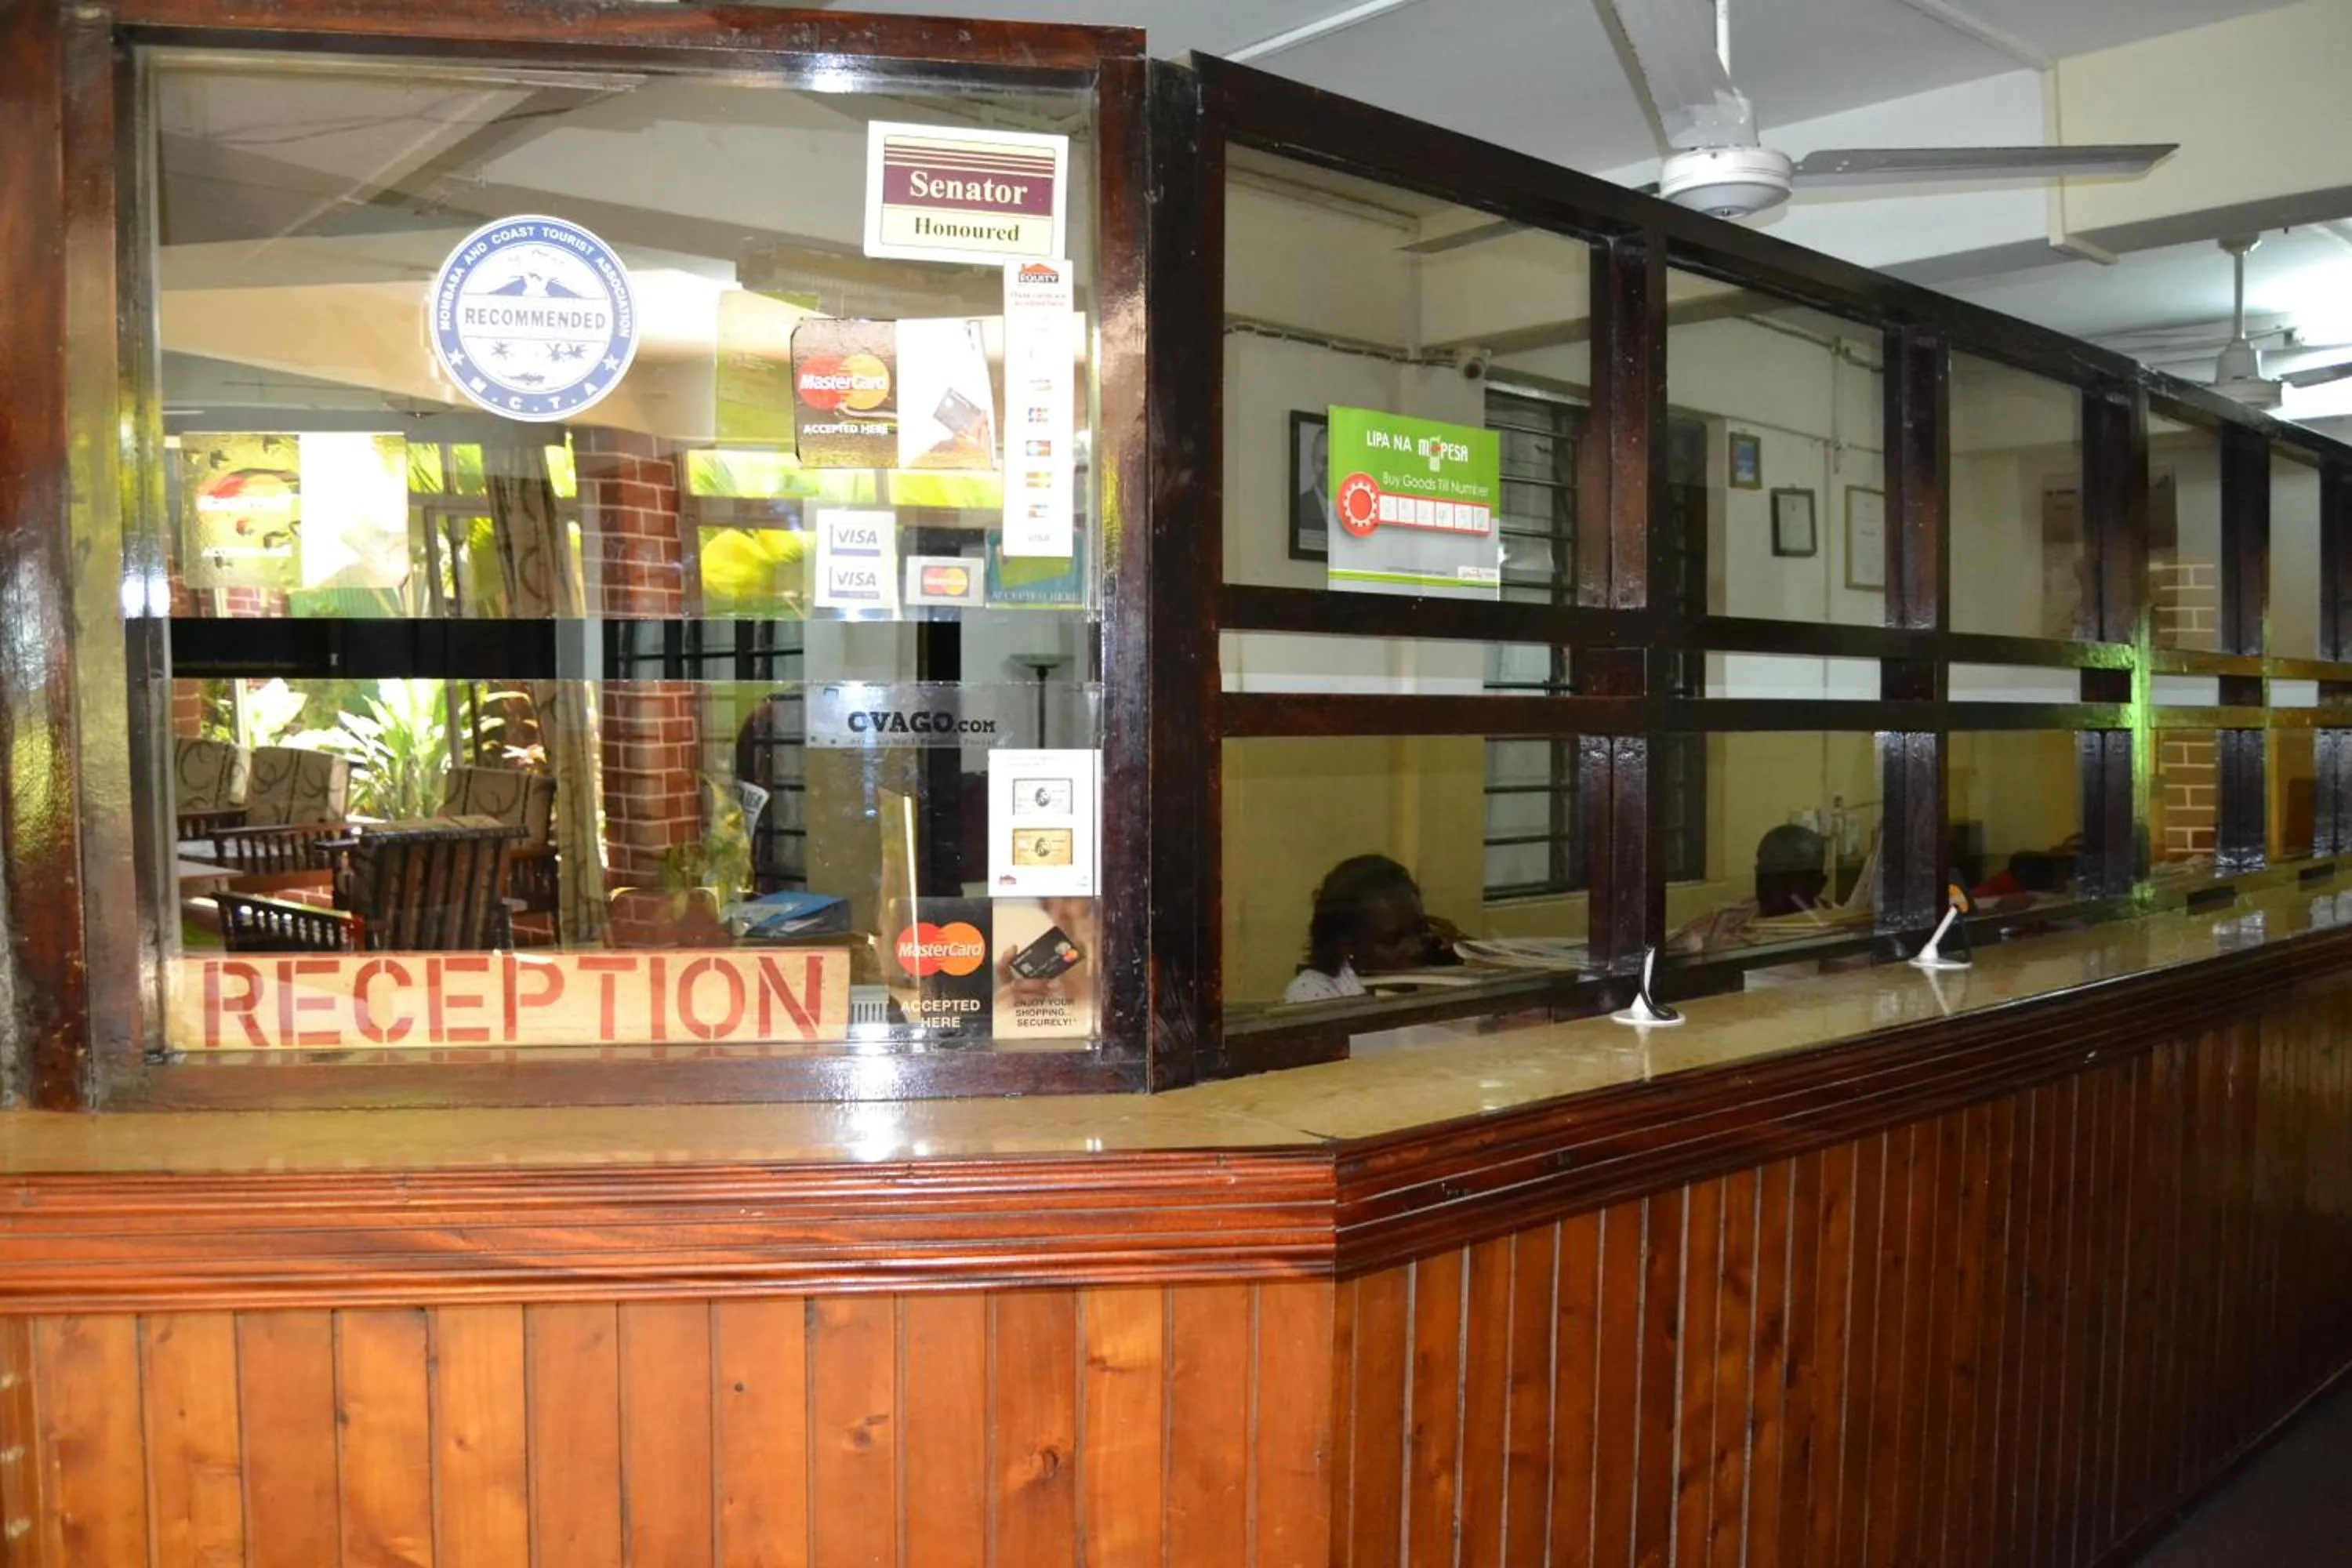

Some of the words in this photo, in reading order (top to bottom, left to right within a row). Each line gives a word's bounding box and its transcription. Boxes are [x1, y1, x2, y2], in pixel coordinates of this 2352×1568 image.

[909, 169, 1029, 205] Senator
[914, 216, 1020, 241] Honoured
[439, 267, 465, 331] MOMBASA
[463, 241, 488, 266] AND
[491, 226, 535, 245] COAST
[542, 226, 594, 256] TOURIST
[593, 256, 631, 339] ASSOCIATION
[464, 307, 607, 330] RECOMMENDED
[799, 375, 887, 390] MasterCard
[803, 423, 858, 435] ACCEPTED
[861, 423, 889, 436] HERE
[1367, 430, 1390, 449] LIPA
[1393, 434, 1411, 452] NA
[1382, 471, 1400, 488] Buy
[1403, 474, 1436, 491] Goods
[1437, 478, 1450, 492] Till
[1451, 480, 1489, 497] Number
[837, 529, 878, 545] VISA
[837, 572, 877, 586] VISA
[898, 942, 983, 956] MasterCard
[201, 953, 822, 1047] RECEPTION
[901, 1000, 981, 1012] ACCEPTED
[1014, 998, 1044, 1007] ENJOY
[1047, 996, 1075, 1006] YOUR
[921, 1017, 961, 1029] HERE
